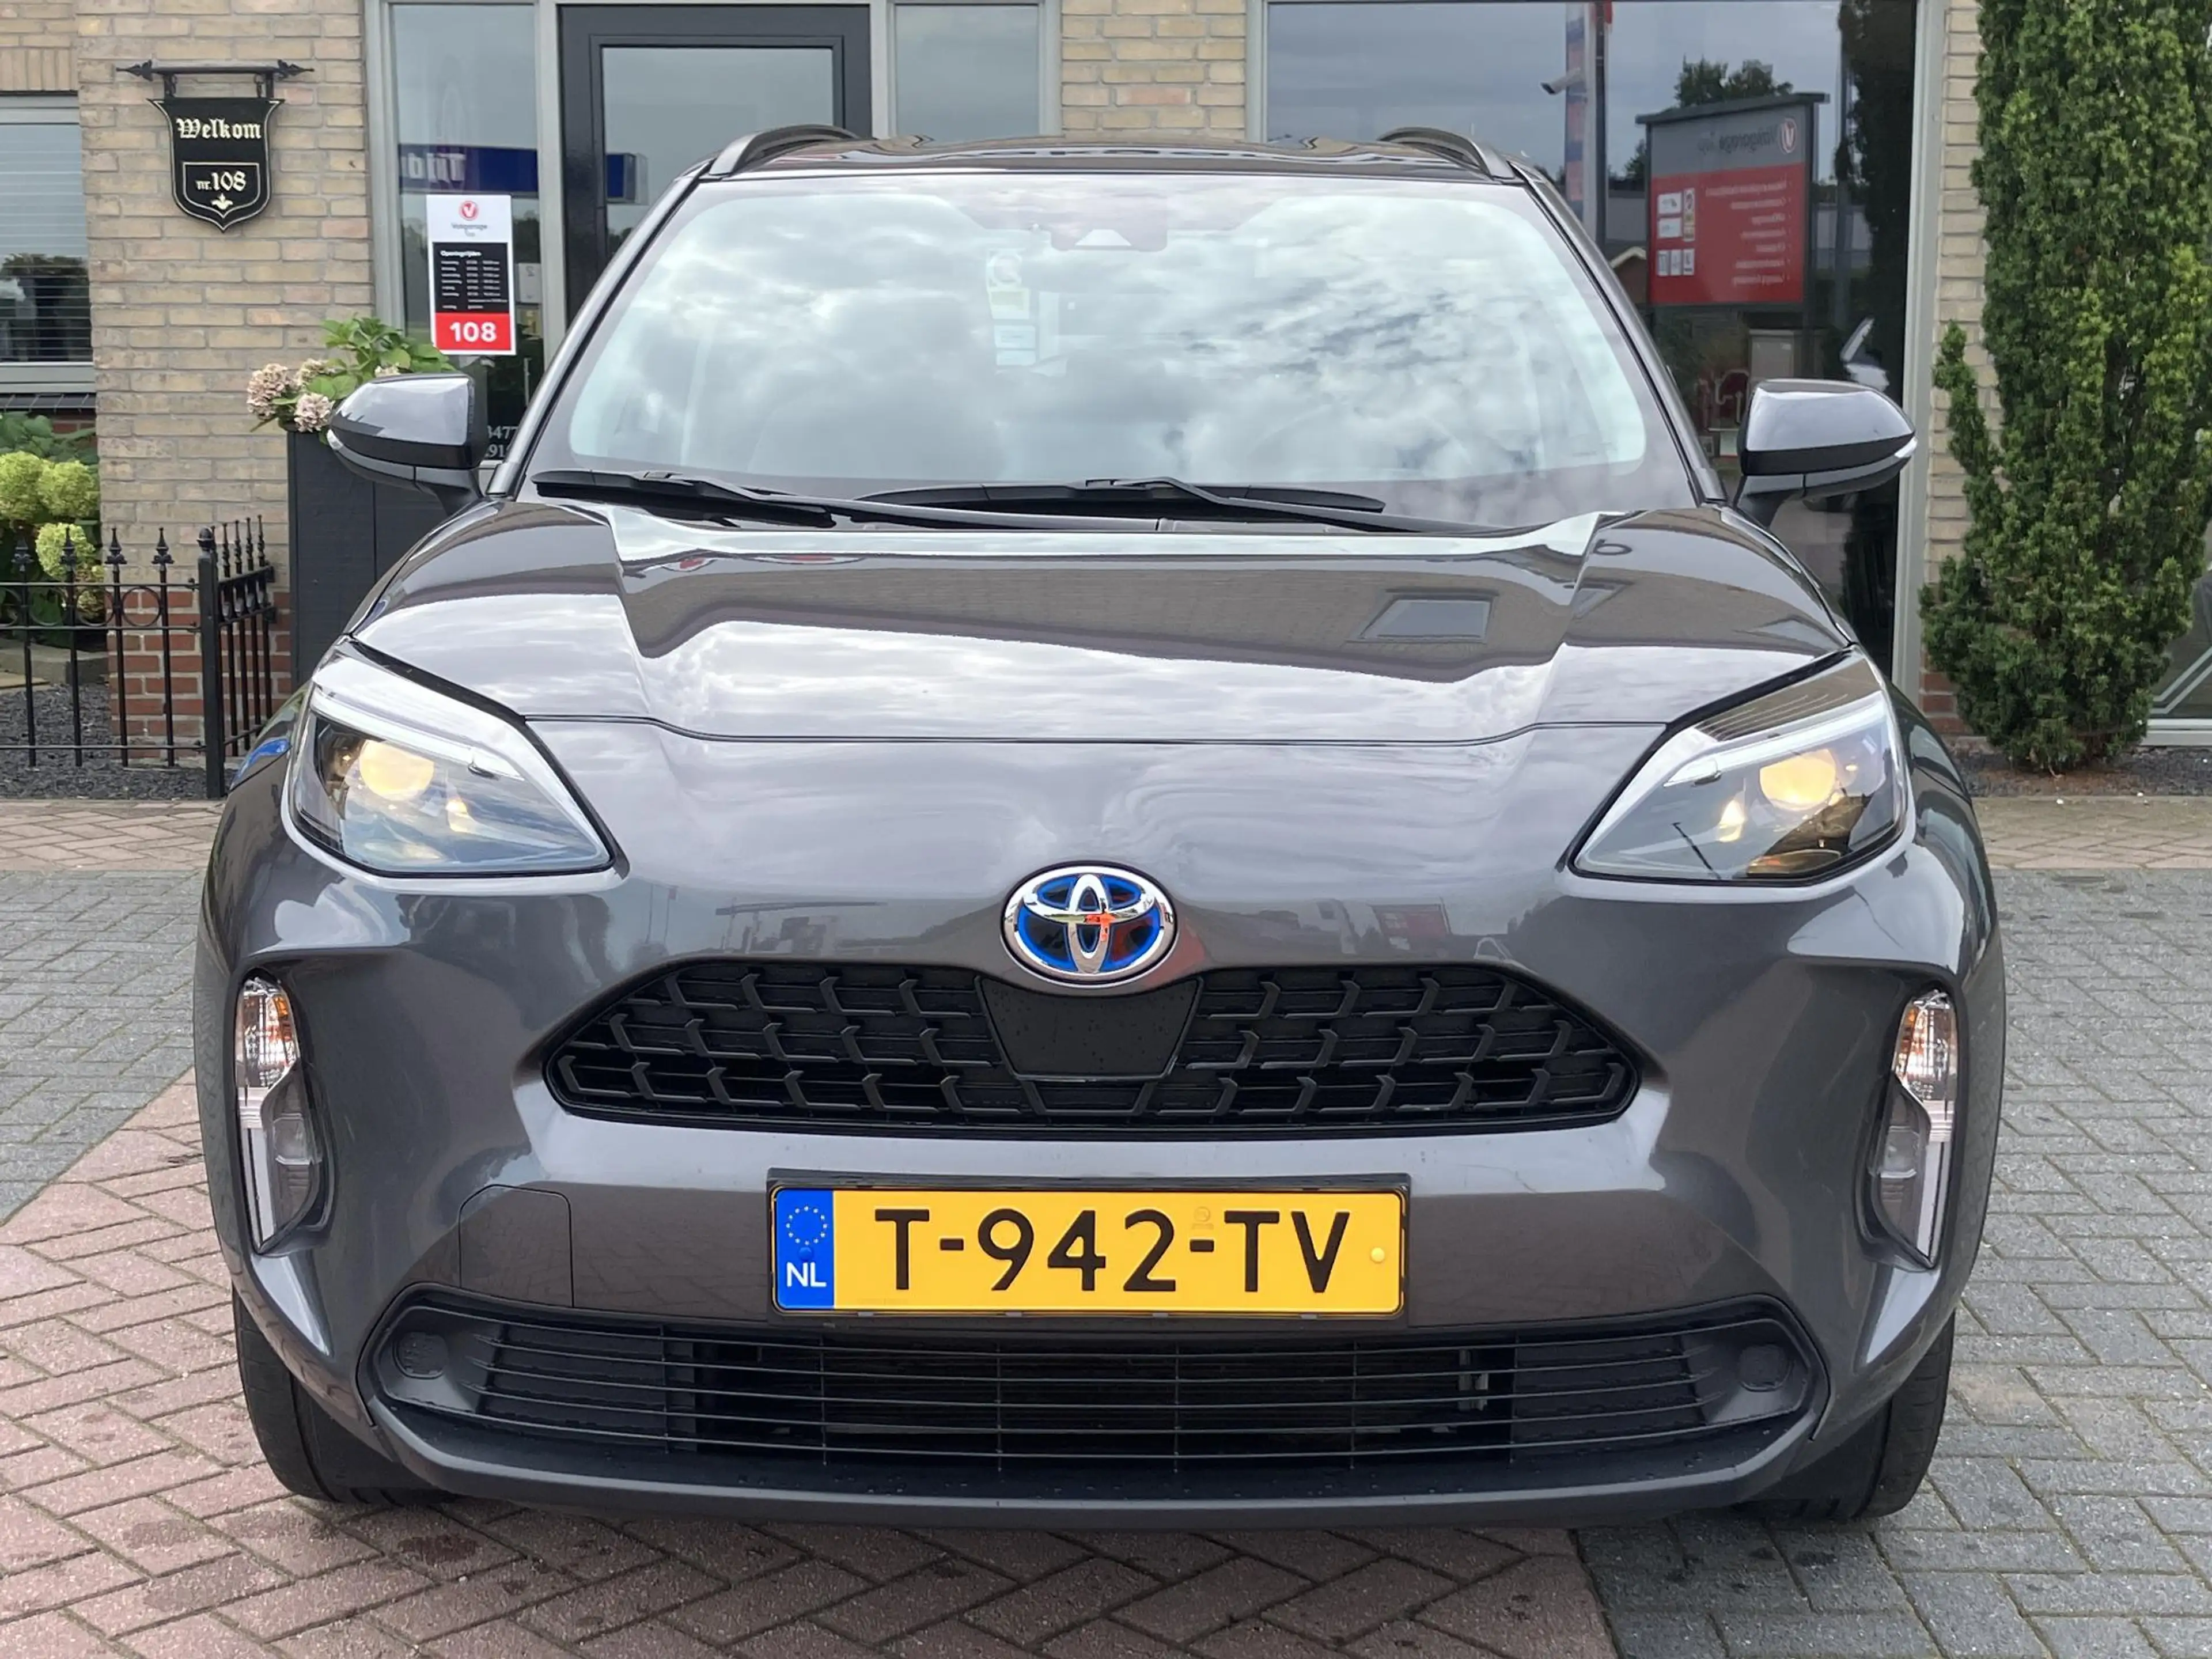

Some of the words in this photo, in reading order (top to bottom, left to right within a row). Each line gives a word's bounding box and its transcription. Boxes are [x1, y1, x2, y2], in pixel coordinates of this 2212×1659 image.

[176, 118, 262, 139] Welkom
[449, 321, 497, 343] 108
[874, 1208, 1350, 1293] T-942-TV
[786, 1262, 827, 1287] NL
